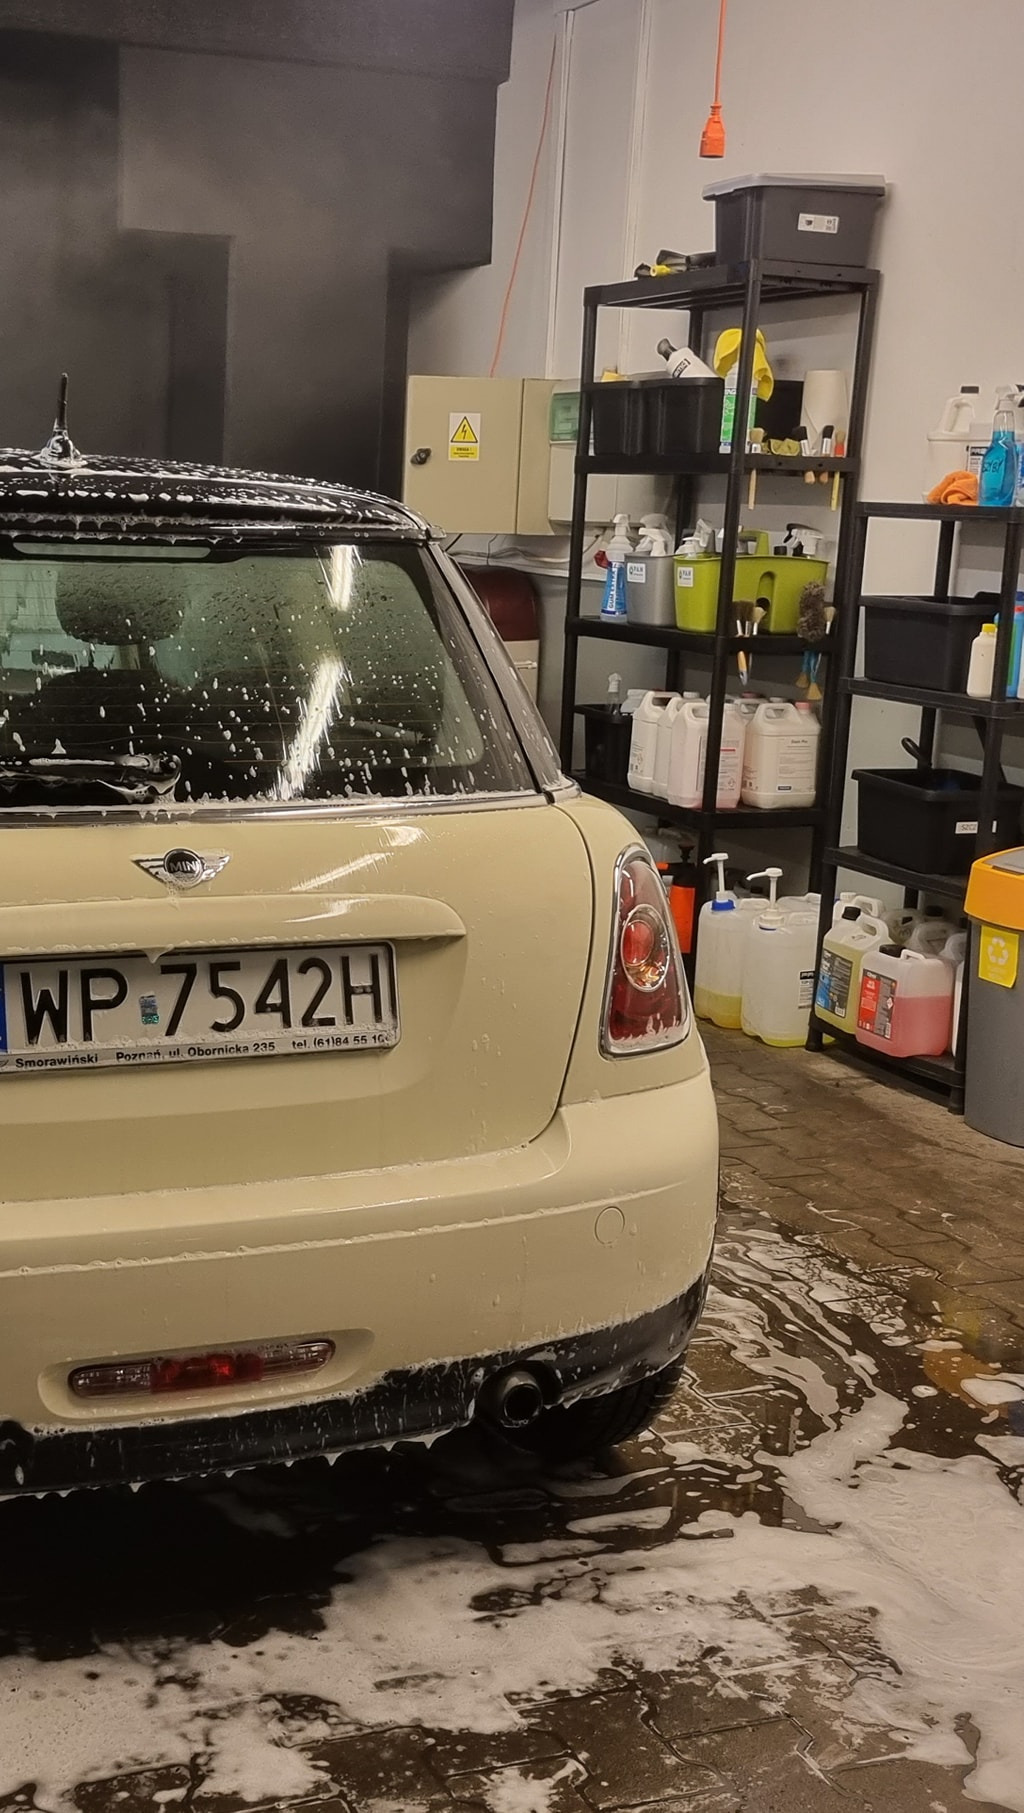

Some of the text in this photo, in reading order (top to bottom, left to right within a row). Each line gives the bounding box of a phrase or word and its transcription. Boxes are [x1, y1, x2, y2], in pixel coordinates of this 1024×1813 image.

[20, 953, 383, 1046] WP 7542H
[15, 1053, 98, 1068] Smorawiński
[187, 1044, 249, 1058] Obornicka
[253, 1042, 276, 1053] 235
[292, 1039, 310, 1049] tel.
[353, 1034, 368, 1045] 55
